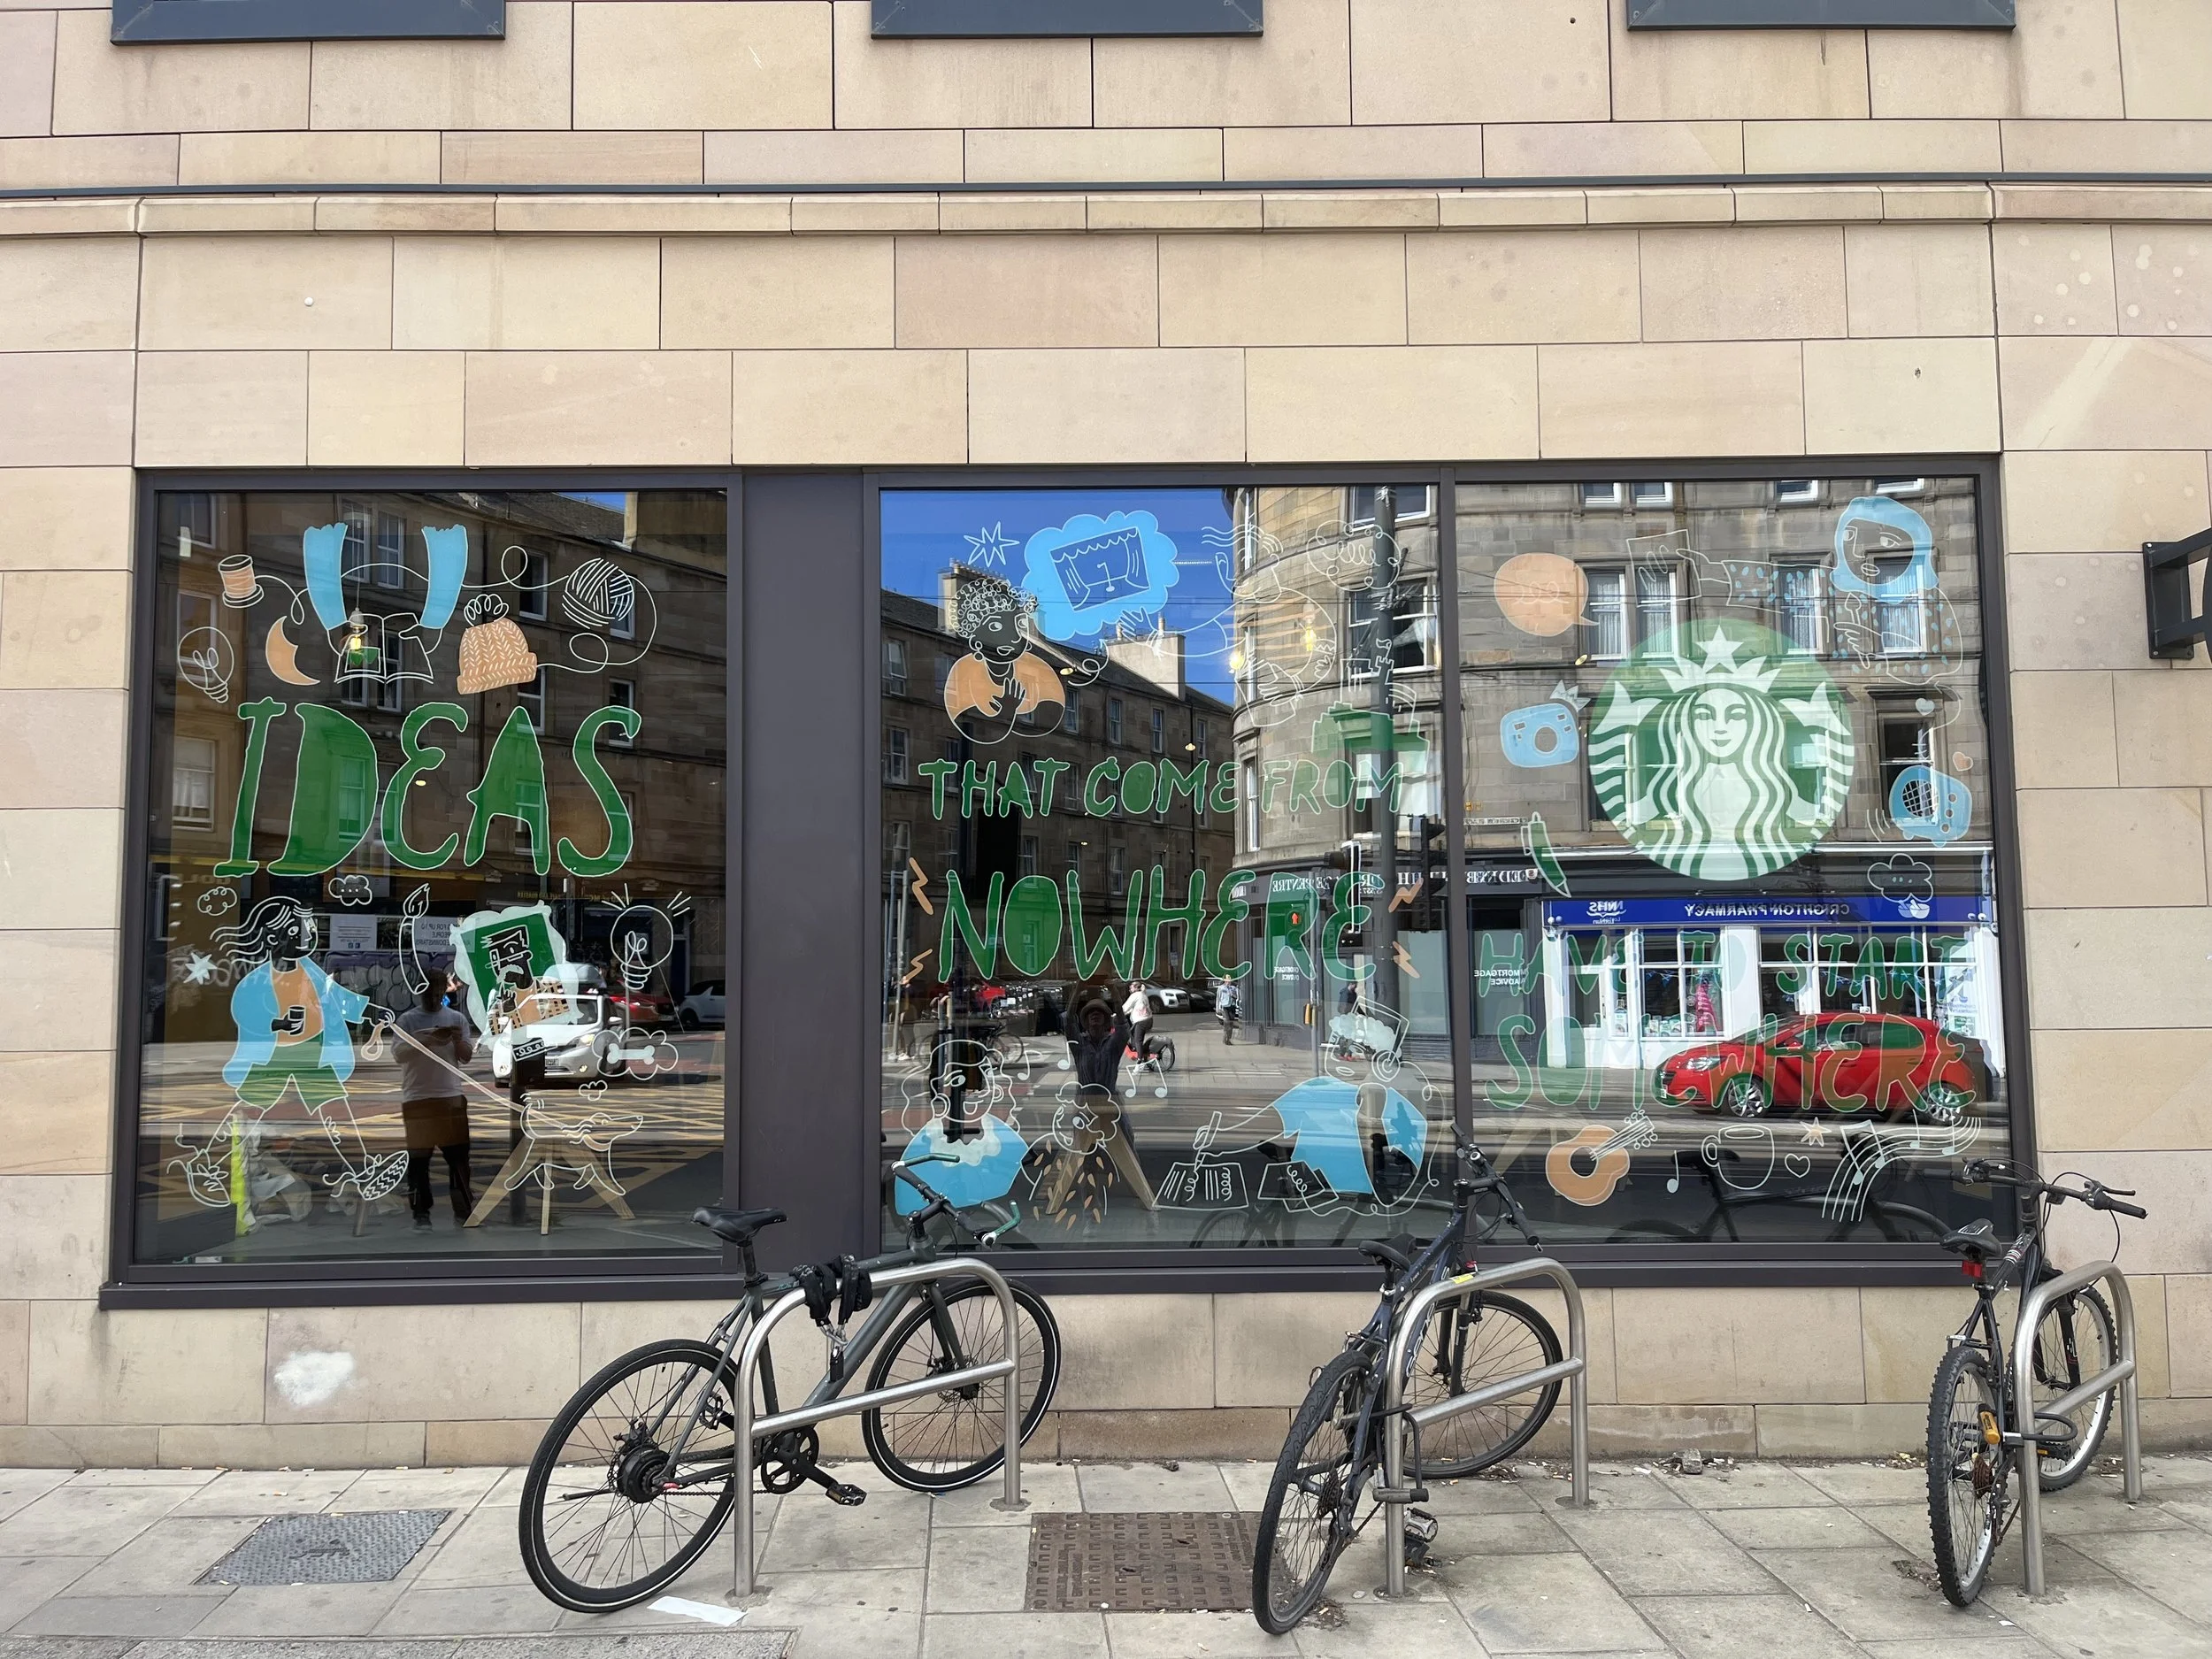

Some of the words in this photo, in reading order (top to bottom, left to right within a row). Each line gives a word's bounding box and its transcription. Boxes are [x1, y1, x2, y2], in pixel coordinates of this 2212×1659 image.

[213, 696, 642, 878] IDEAS
[918, 757, 1070, 820] THAT
[1083, 756, 1240, 817] COME
[1261, 759, 1405, 815] FROM
[938, 864, 1386, 983] NOWHERE
[1479, 929, 1645, 998] HAVE
[1678, 930, 1747, 994] TO
[1776, 933, 1970, 1005] START
[1485, 1012, 1978, 1114] SOMEWHERE
